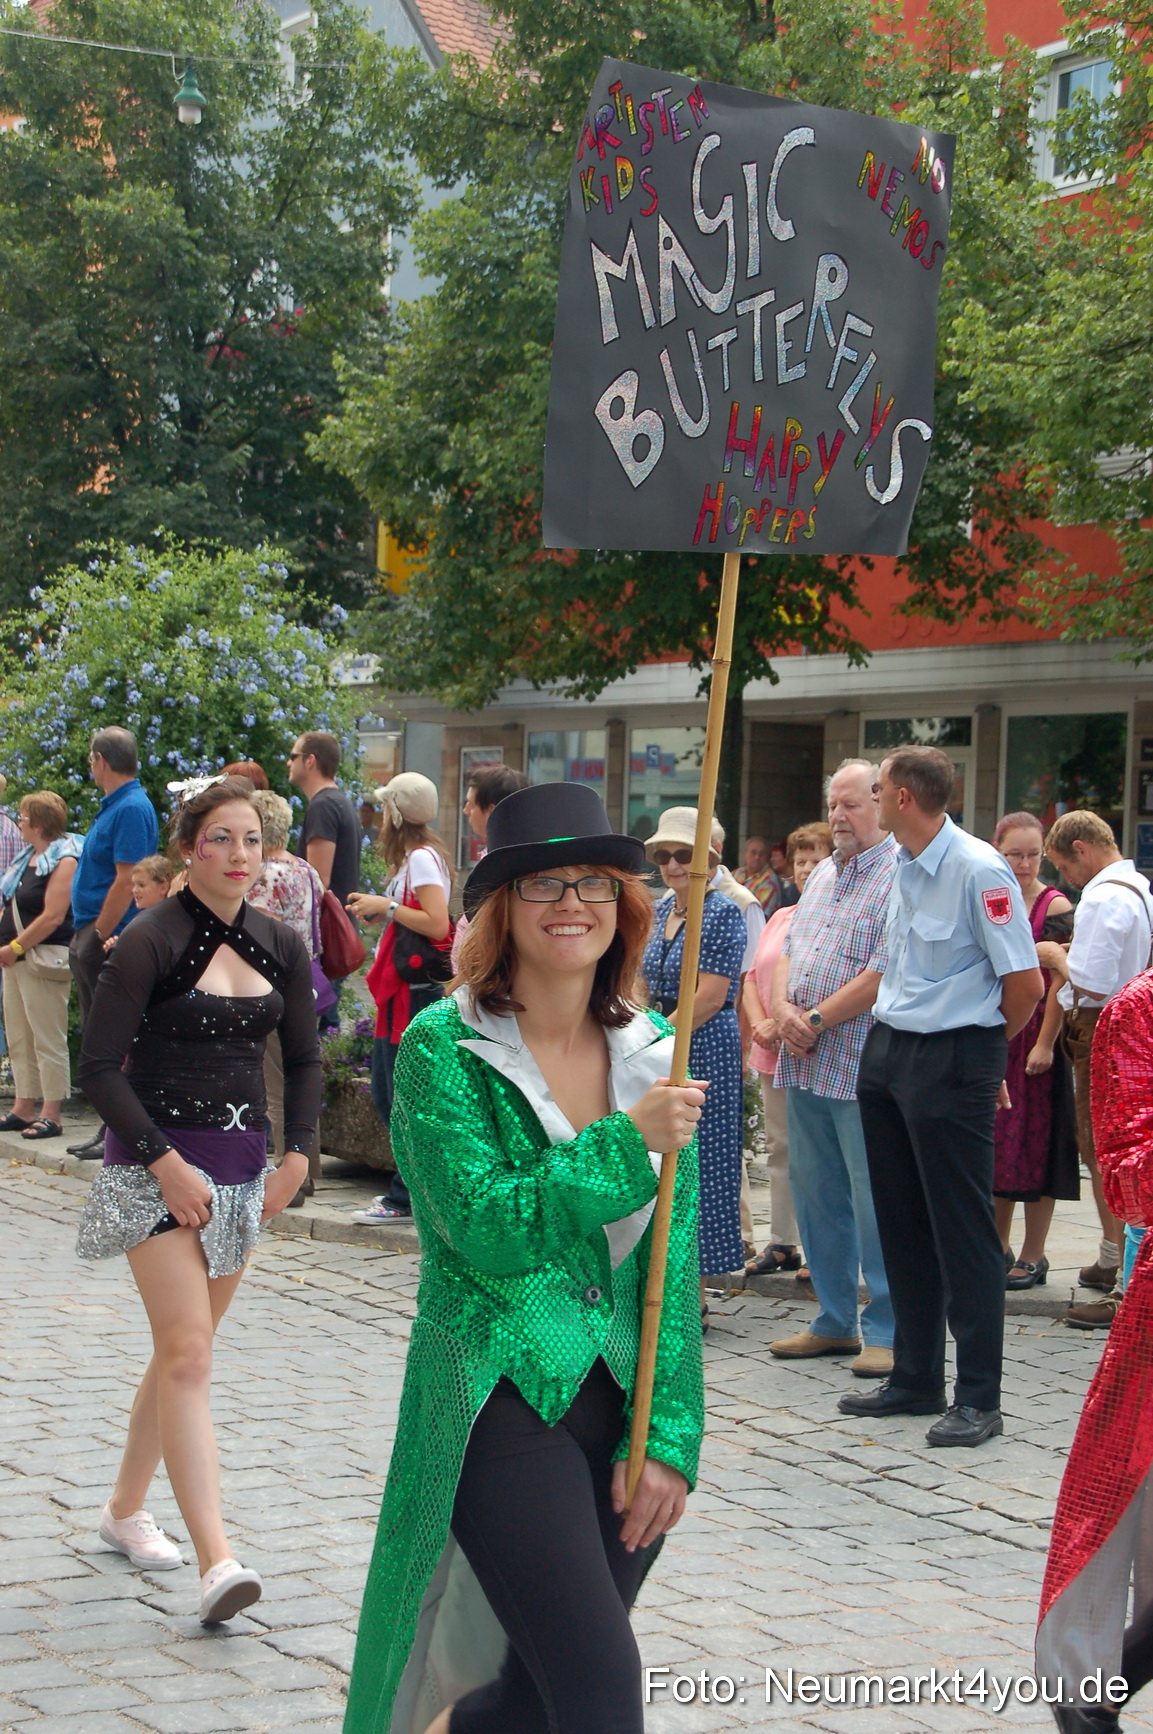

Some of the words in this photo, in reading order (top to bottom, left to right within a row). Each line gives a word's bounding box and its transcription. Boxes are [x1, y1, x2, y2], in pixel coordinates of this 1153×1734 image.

[577, 80, 710, 162] ARTISTEN
[911, 136, 946, 194] NO
[580, 155, 658, 216] KIDS
[856, 149, 945, 270] NEMOS
[590, 126, 817, 346] MAGIC
[594, 253, 933, 505] BUTTERFLYS
[722, 401, 846, 505] HAPPY
[692, 481, 818, 547] HOPPERS
